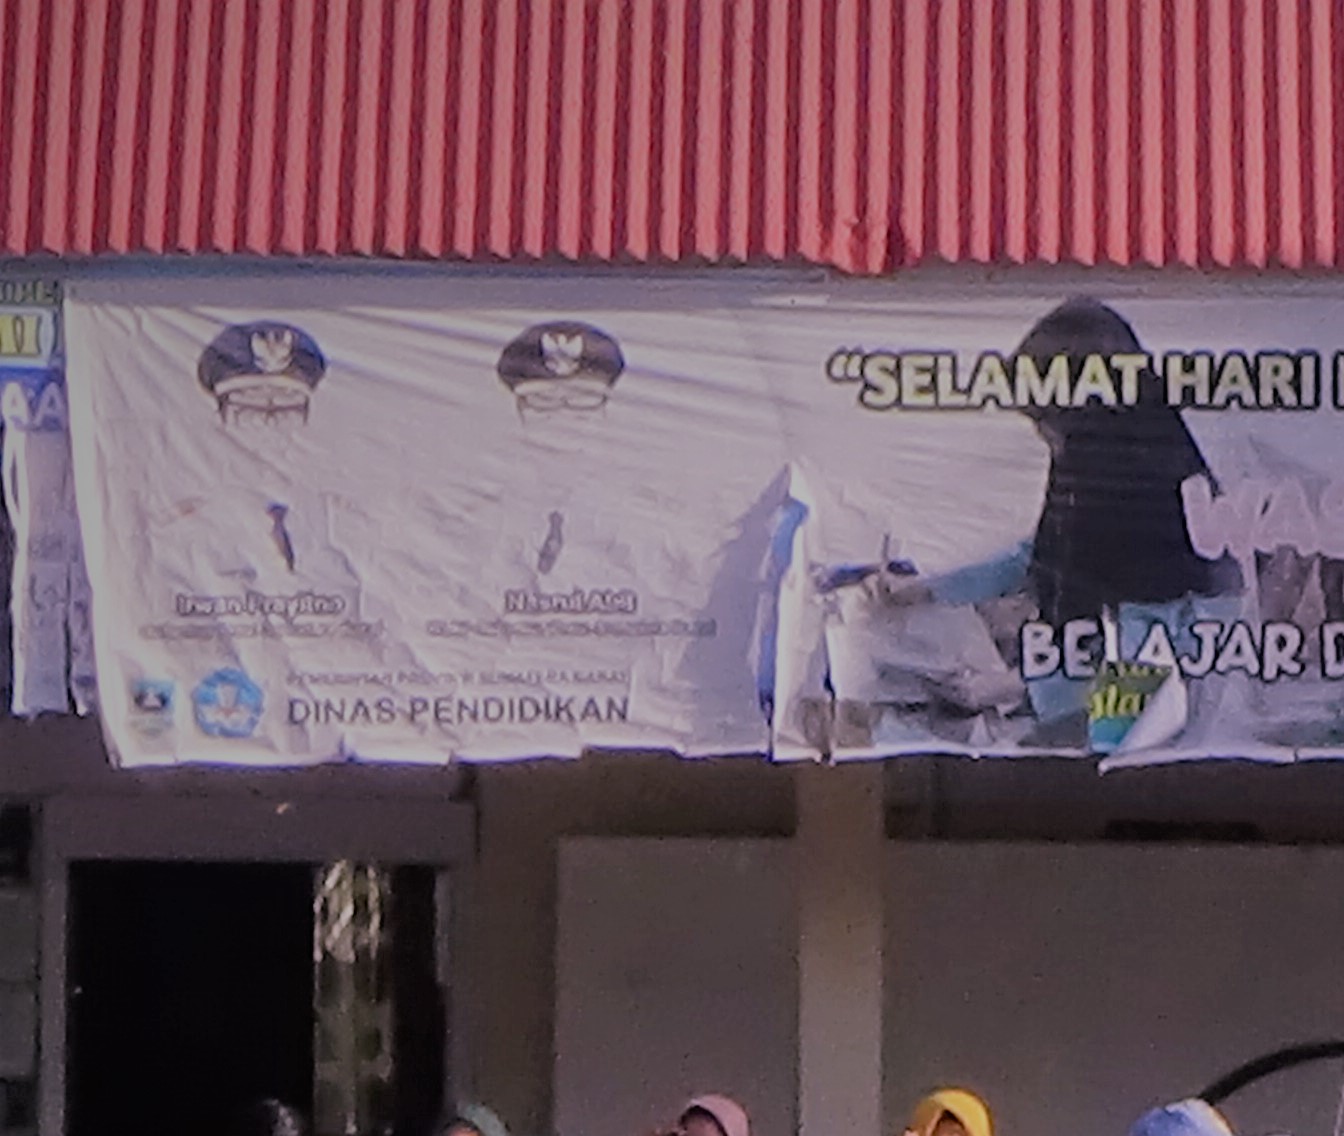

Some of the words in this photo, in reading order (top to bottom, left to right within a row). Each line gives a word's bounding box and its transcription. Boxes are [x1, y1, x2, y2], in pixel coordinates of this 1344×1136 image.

[1160, 348, 1318, 411] HARI
[288, 697, 397, 727] DINAS
[408, 696, 631, 725] PENDIDIKAN
